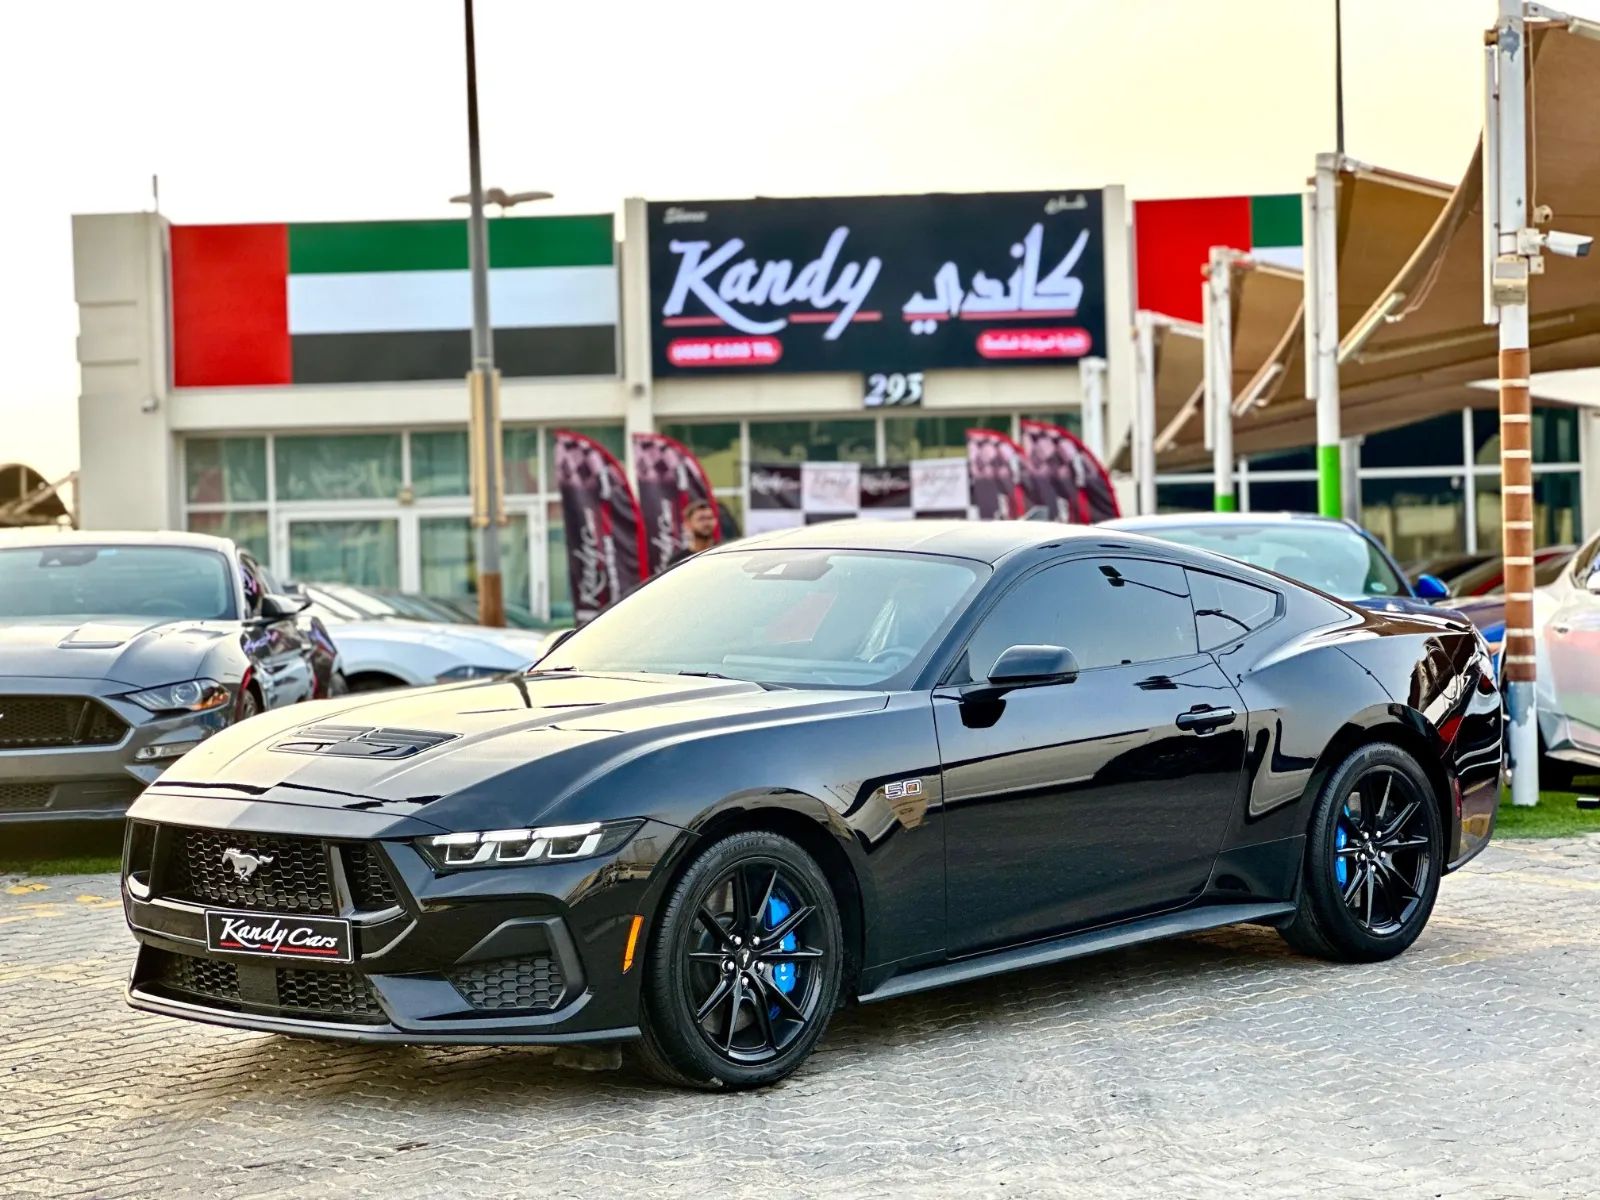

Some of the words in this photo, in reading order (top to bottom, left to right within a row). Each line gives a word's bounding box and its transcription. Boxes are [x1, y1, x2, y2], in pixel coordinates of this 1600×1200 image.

[662, 226, 882, 340] Kandy
[864, 372, 924, 406] 295
[220, 918, 288, 952] Kandy
[288, 928, 338, 948] Cars
